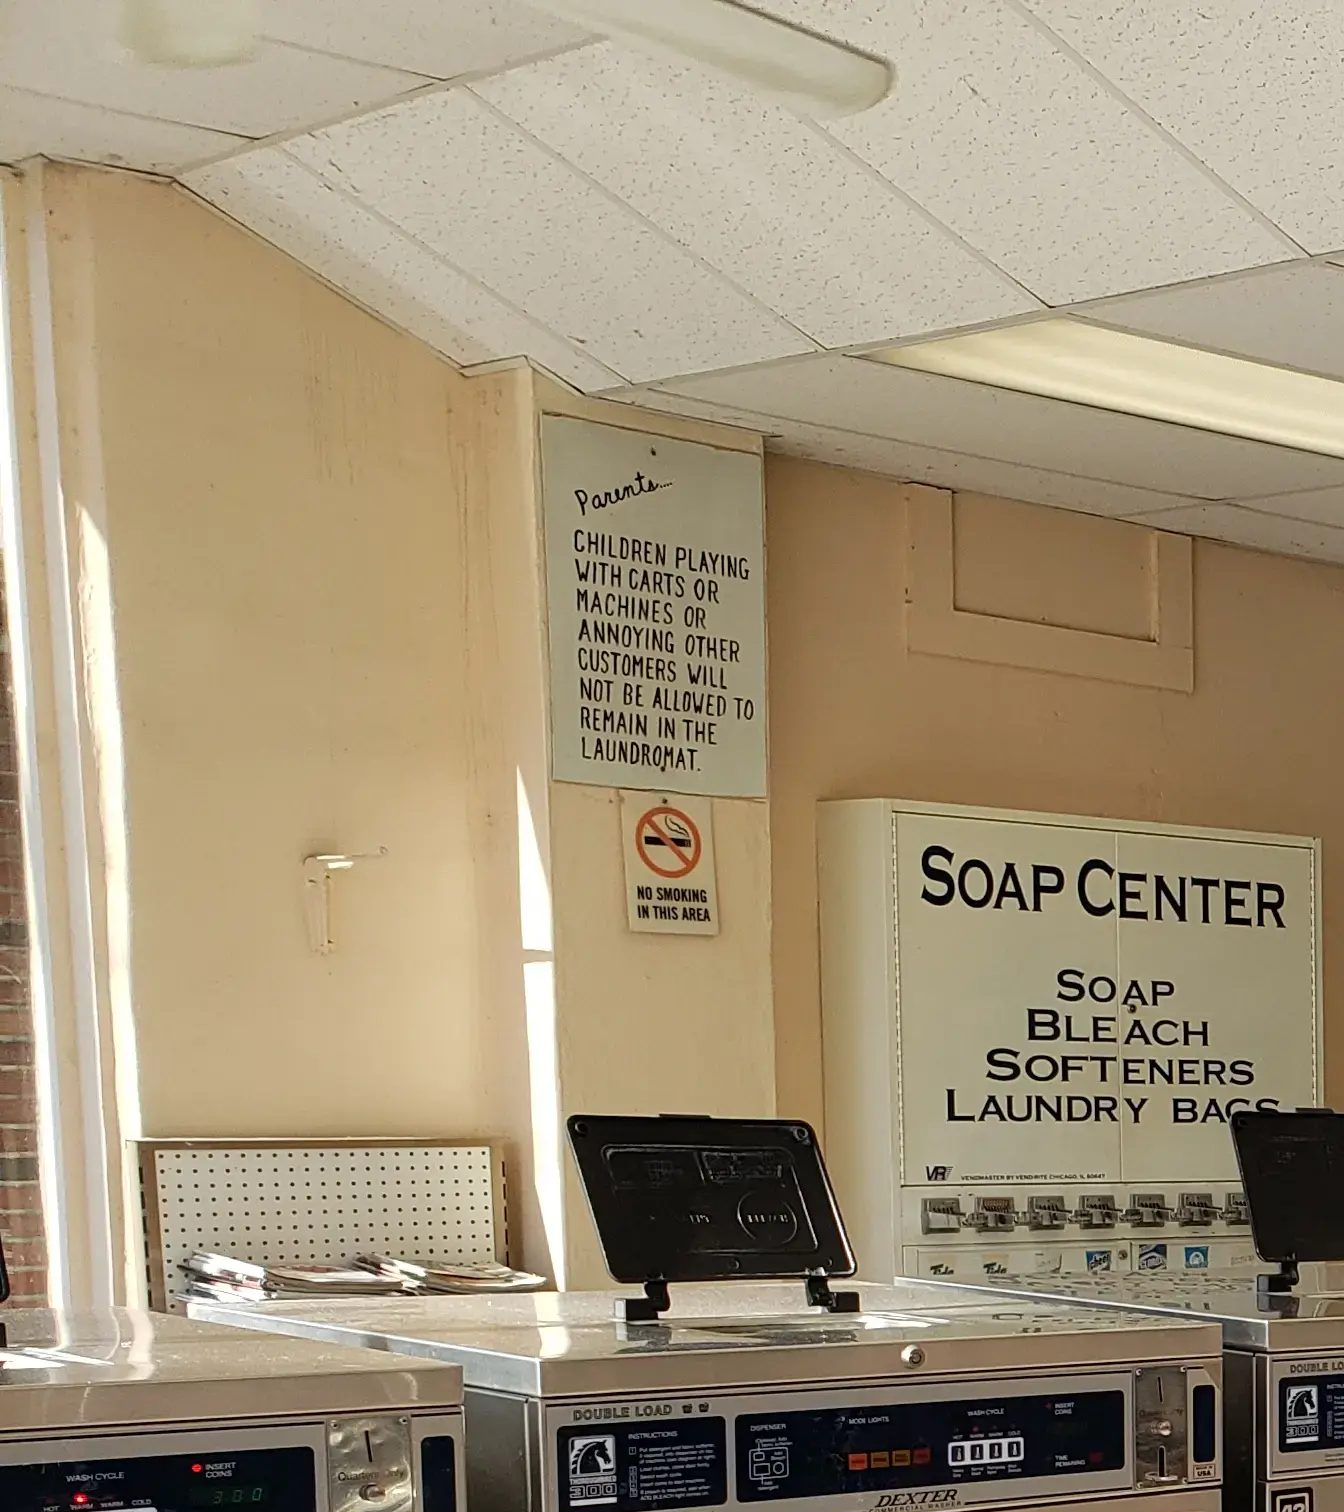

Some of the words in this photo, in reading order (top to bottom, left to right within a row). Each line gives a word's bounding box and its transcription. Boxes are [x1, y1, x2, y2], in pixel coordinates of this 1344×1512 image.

[574, 529, 667, 566] CHILDREN
[675, 547, 750, 580] PLAYING
[575, 558, 622, 589] WITH
[628, 568, 685, 598] CARTS
[694, 578, 719, 604] OR
[576, 588, 673, 624] MACHINES
[684, 605, 706, 629] OR
[578, 618, 675, 654] ANNOYING
[685, 634, 740, 663] OTHER
[578, 648, 676, 683] CUSTOMERS
[687, 663, 727, 690] WILL
[579, 677, 614, 703] NOT
[623, 683, 644, 707] BE
[652, 686, 727, 718] ALLOWED
[733, 697, 754, 721] TO
[580, 706, 647, 738] REMAIN
[658, 715, 676, 740] IN
[682, 718, 717, 746] THE
[581, 737, 702, 772] LAUNDROMAT.
[637, 886, 652, 900] NO
[656, 887, 708, 903] SMOKING
[920, 844, 1065, 913] SOAP
[1077, 858, 1287, 929] CENTER
[637, 905, 650, 919] IN
[652, 906, 679, 920] THIS
[682, 907, 711, 922] AREA
[1056, 968, 1176, 1007] SOAP
[1026, 1007, 1210, 1047] BLEACH
[985, 1047, 1255, 1086] SOFTENERS
[945, 1088, 1149, 1124] LAUNDRY
[1290, 1363, 1328, 1373] DOUBLE
[573, 1407, 630, 1421] DOUBLE
[635, 1404, 673, 1418] LOAD
[66, 1473, 93, 1482] WASH
[95, 1472, 124, 1480] CYCLE
[205, 1461, 236, 1470] INSERT
[205, 1469, 233, 1478] COINS
[1197, 1469, 1211, 1477] USA
[875, 1489, 958, 1508] DEXTER
[928, 1500, 962, 1511] WASHER
